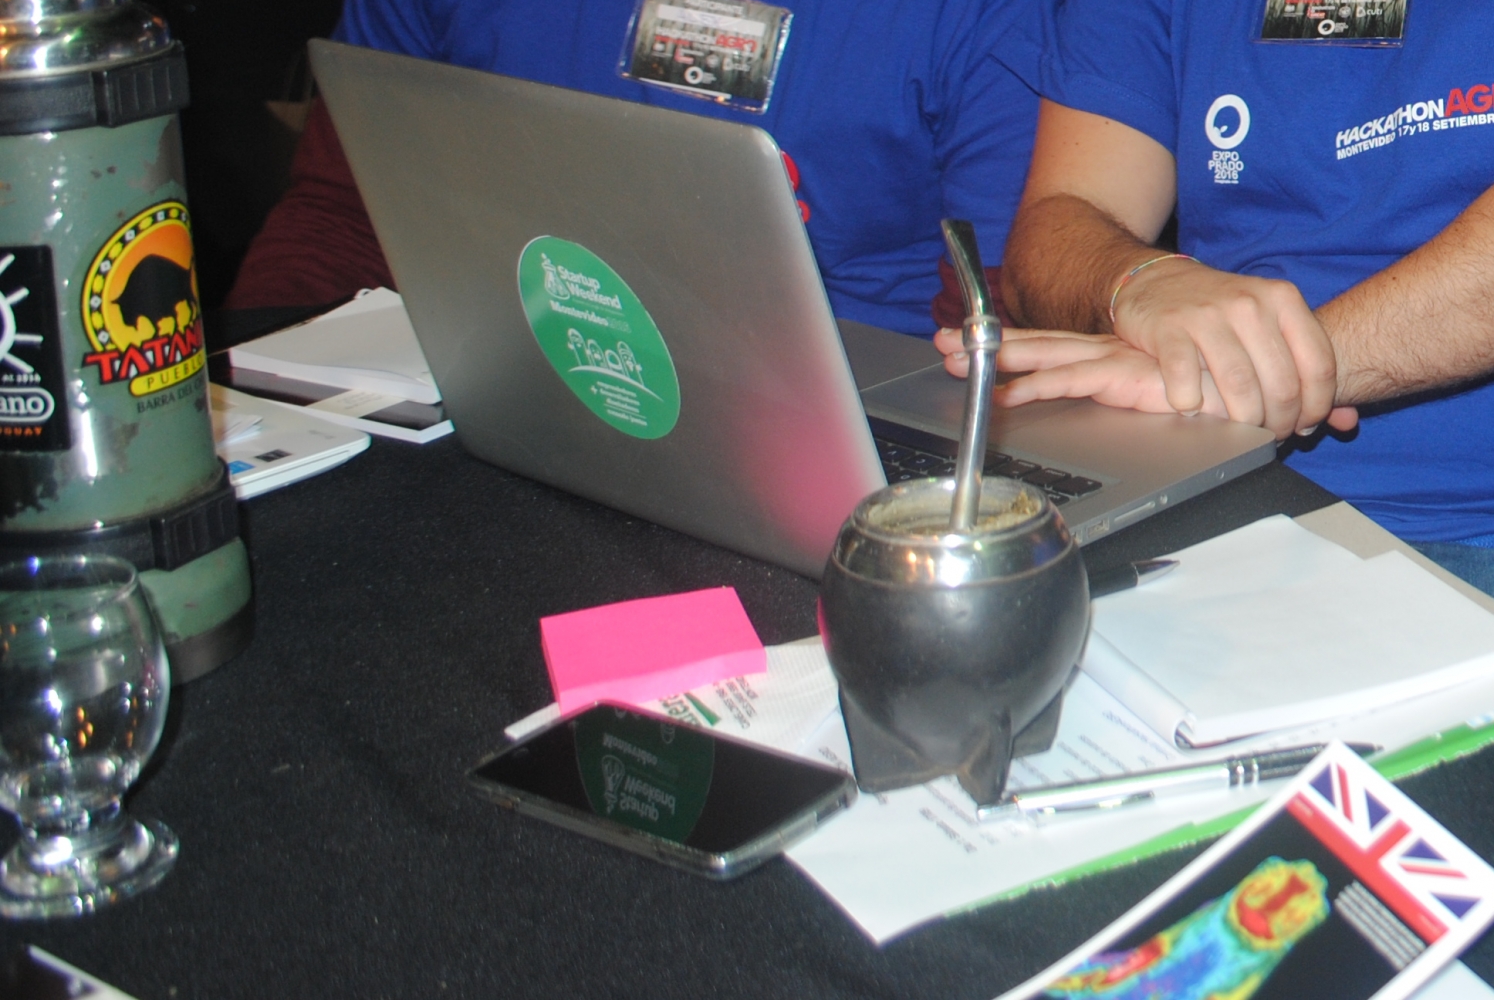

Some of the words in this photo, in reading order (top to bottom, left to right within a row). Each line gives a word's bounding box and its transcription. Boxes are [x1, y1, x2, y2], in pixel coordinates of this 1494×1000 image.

[1212, 150, 1239, 161] EXPO
[1337, 131, 1396, 160] MONTEVIDEO
[1208, 160, 1244, 171] PRADO
[1214, 170, 1238, 180] 2016
[557, 265, 600, 291] Startup
[565, 280, 622, 310] Weekend
[138, 392, 176, 413] BARRA
